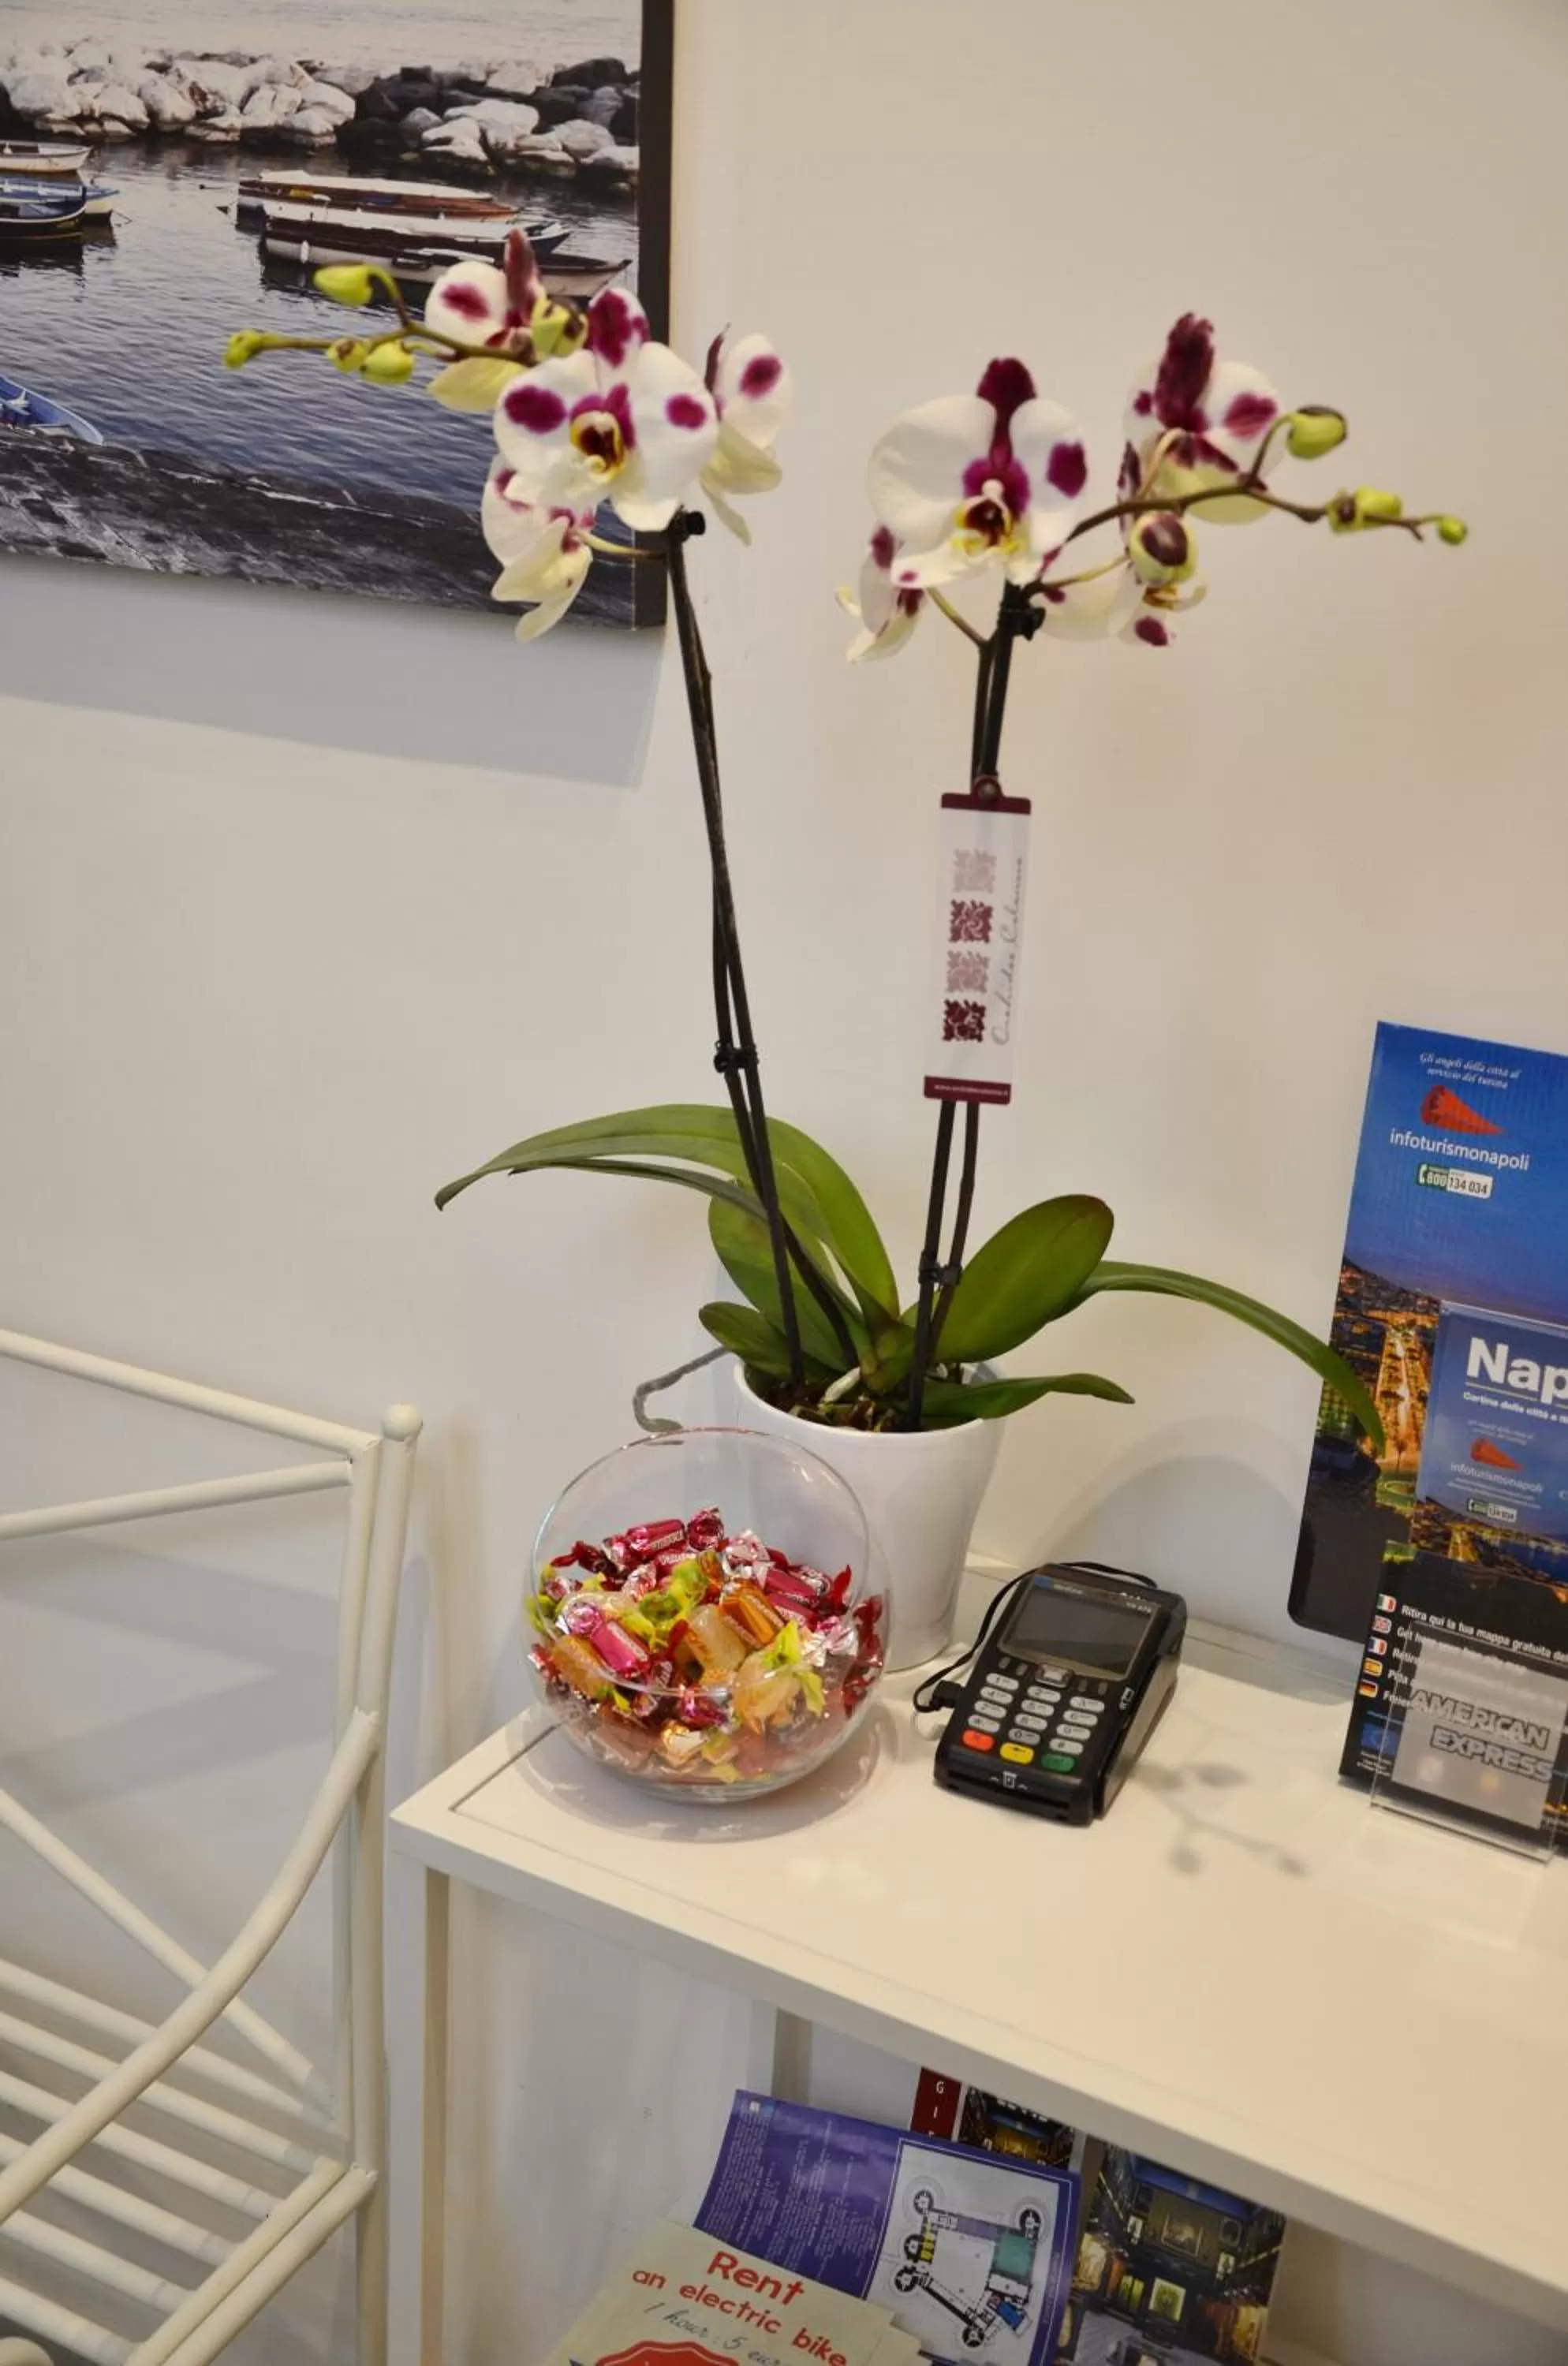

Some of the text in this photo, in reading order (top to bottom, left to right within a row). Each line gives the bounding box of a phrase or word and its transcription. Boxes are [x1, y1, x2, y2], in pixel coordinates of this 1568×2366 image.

[1390, 1128, 1530, 1170] infoturismonapoli
[1466, 1337, 1568, 1405] Nap
[1476, 1628, 1510, 1648] mappa
[1512, 1637, 1552, 1659] gratuita
[1410, 1689, 1550, 1752] AMERICAN
[1429, 1724, 1555, 1784] EXPRESS
[707, 2251, 805, 2305] Rent
[633, 2269, 847, 2366] an electric bike
